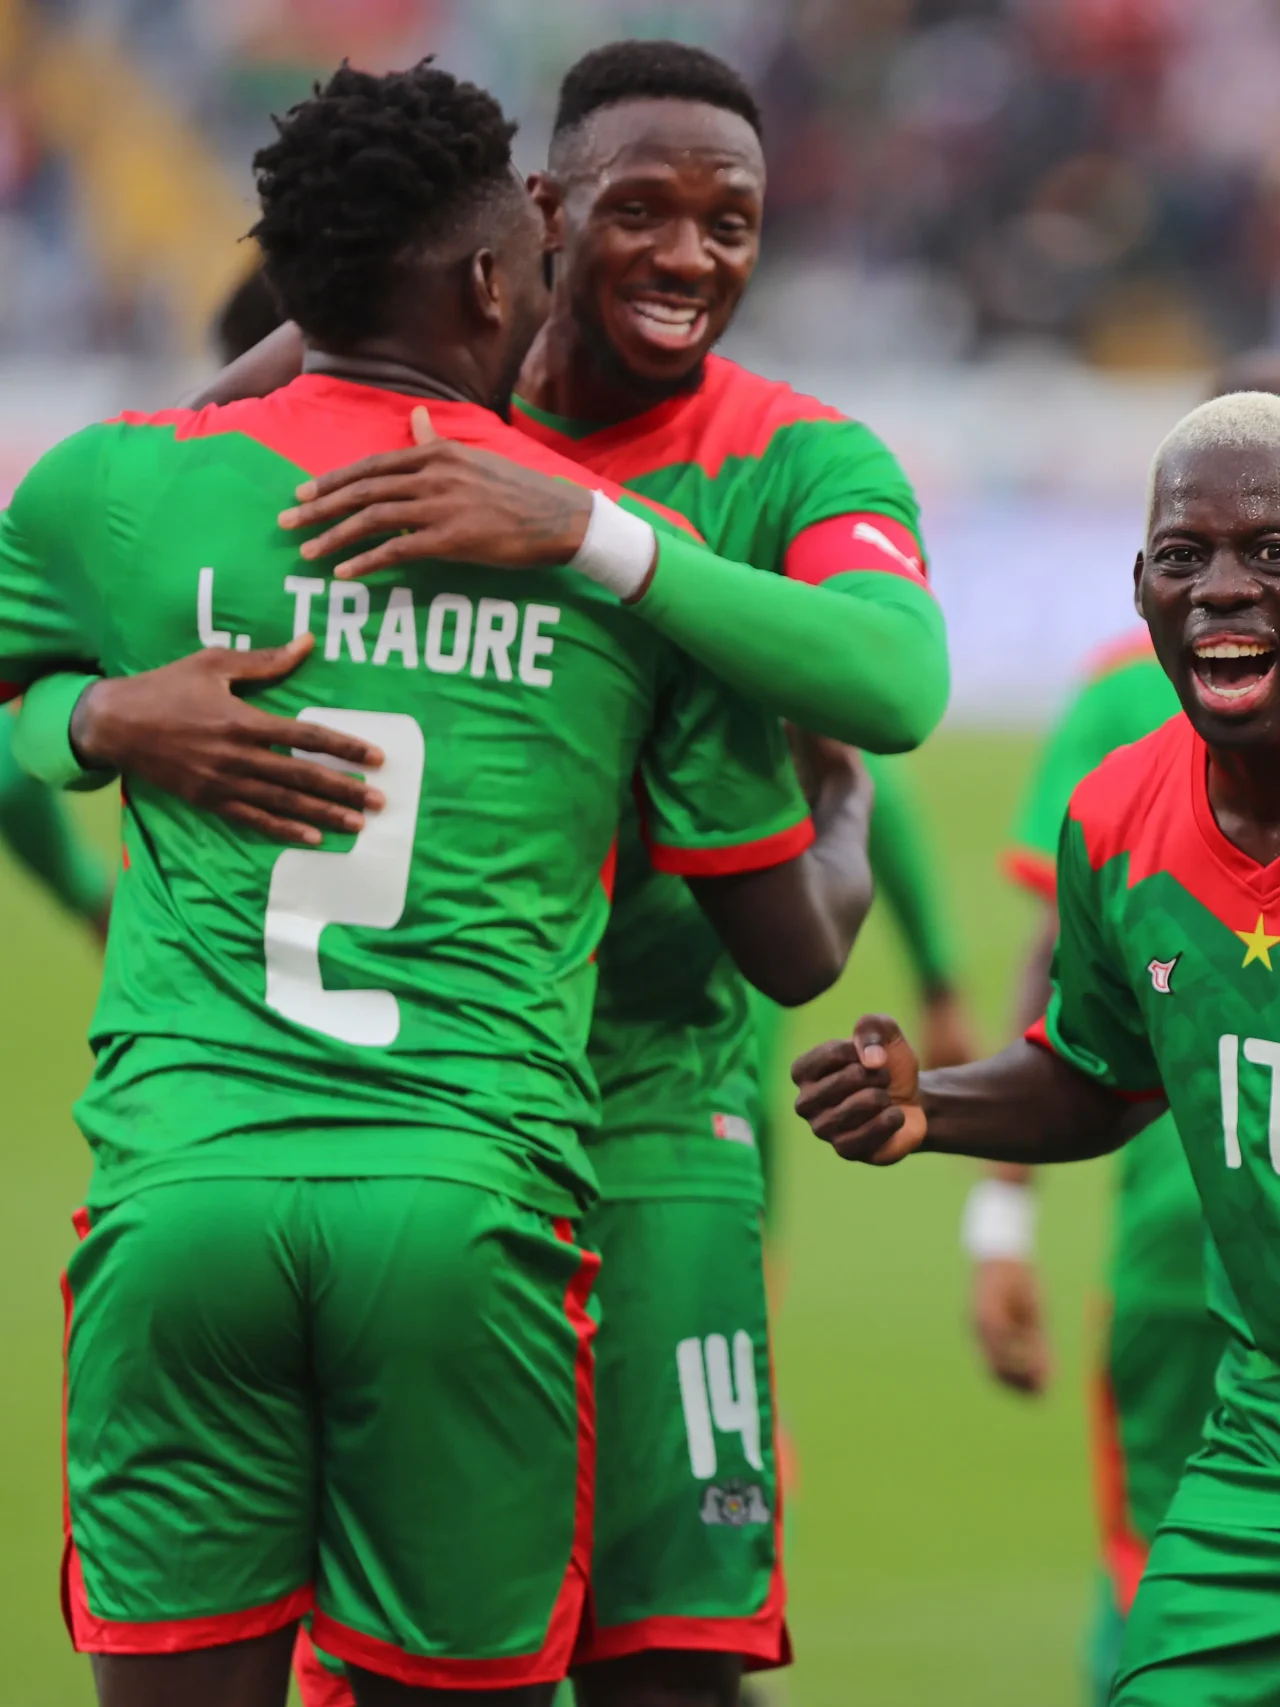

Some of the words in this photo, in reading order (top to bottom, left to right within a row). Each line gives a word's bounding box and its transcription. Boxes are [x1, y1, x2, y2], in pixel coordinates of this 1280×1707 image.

[197, 567, 251, 652] L.
[284, 574, 561, 688] TRAORE
[264, 706, 425, 1047] 2
[676, 1328, 764, 1480] 14
